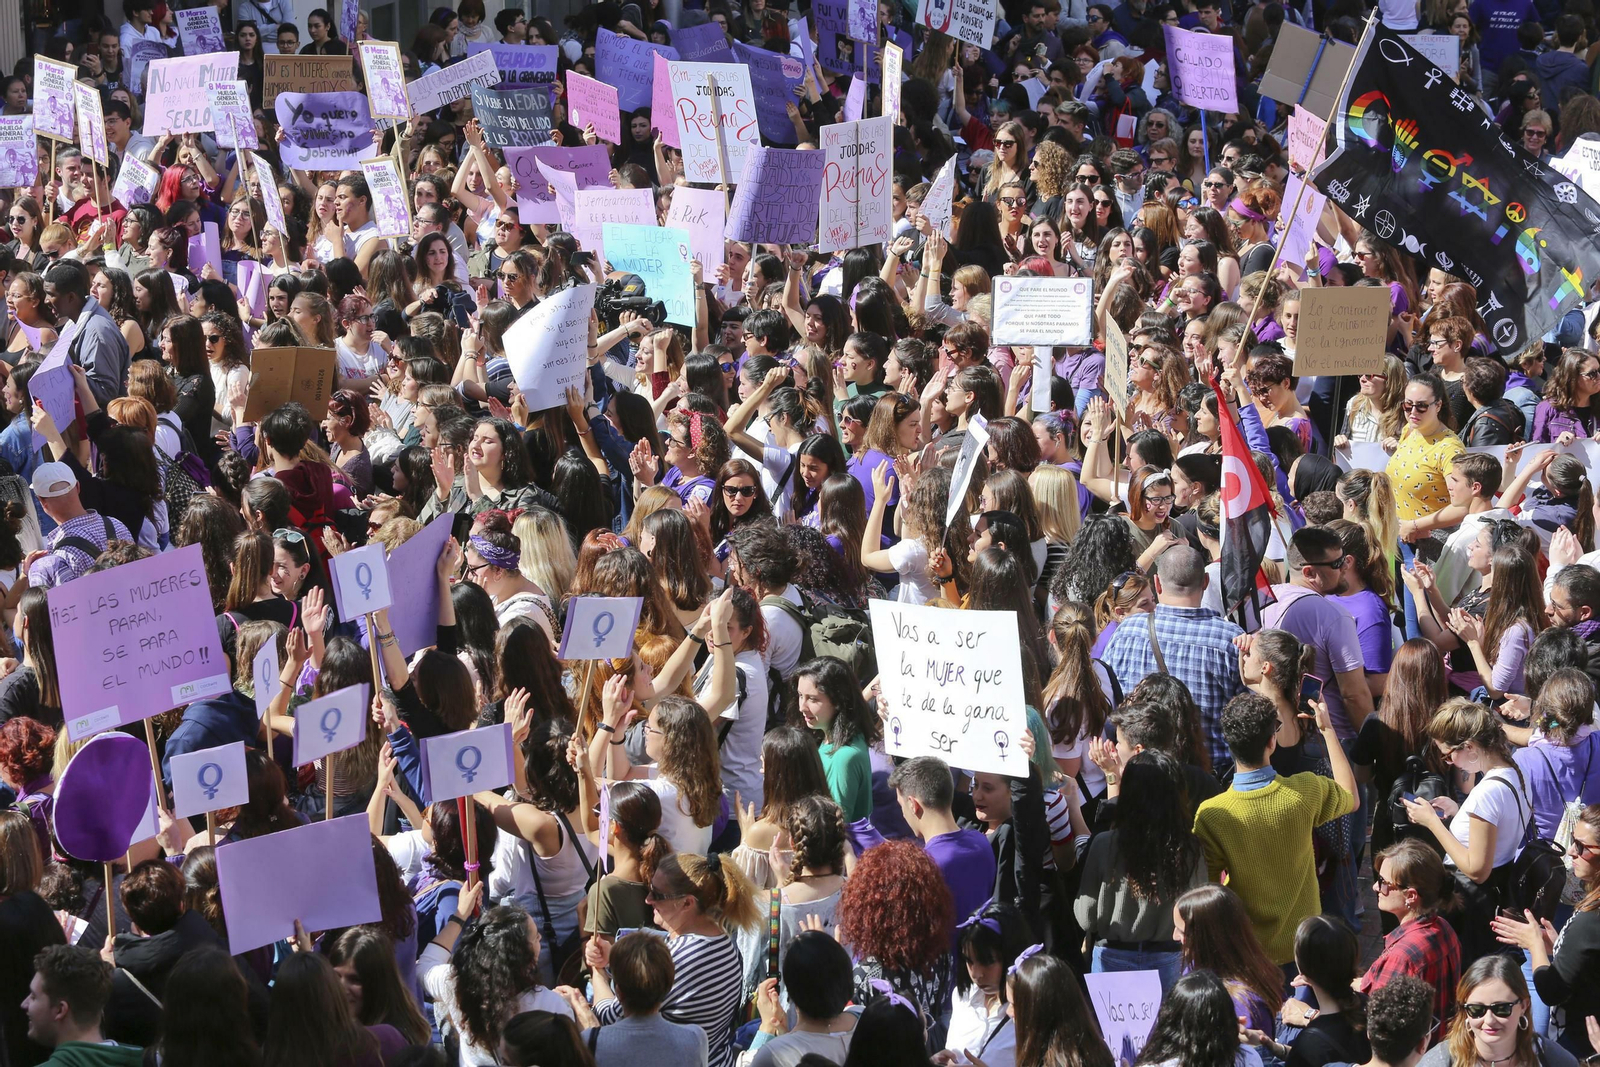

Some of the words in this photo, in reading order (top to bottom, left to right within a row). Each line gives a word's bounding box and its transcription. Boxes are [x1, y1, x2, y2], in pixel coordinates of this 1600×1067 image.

[600, 32, 628, 50] SOMOS
[632, 44, 642, 55] EL
[959, 26, 984, 44] QUEMAR
[371, 46, 389, 54] Marzo
[1174, 48, 1222, 68] CALLADO
[265, 60, 276, 78] NO
[281, 62, 290, 78] ES
[293, 60, 331, 78] MUJERES
[601, 49, 610, 60] DE
[612, 52, 630, 65] LAS
[634, 60, 650, 71] QUE
[44, 64, 65, 75] Marzo
[508, 70, 517, 82] LA
[518, 70, 556, 83] GRAVEDAD
[618, 68, 654, 86] TIENEN
[150, 66, 170, 94] NO
[1184, 83, 1230, 101] LIBERTAD
[504, 98, 516, 110] LA
[514, 94, 548, 110] EDAD
[161, 106, 212, 130] SERLO
[284, 98, 315, 126] Yo
[320, 104, 358, 132] quiero
[498, 116, 519, 130] ESTOY
[518, 116, 532, 130] DEL
[531, 117, 552, 130] LADO
[340, 130, 355, 139] no
[492, 132, 508, 145] LAS
[840, 140, 876, 160] JODDAS
[131, 159, 149, 176] Marzo
[365, 165, 370, 173] 8
[370, 164, 386, 172] Marzo
[590, 211, 640, 223] REBELDÍA
[797, 204, 818, 223] DE
[612, 226, 630, 241] EL
[624, 243, 639, 256] DE
[646, 246, 660, 258] LA
[622, 258, 666, 275] MUJER
[1308, 296, 1324, 316] Lo
[1332, 304, 1378, 316] contrario
[1310, 318, 1322, 330] al
[1327, 316, 1376, 331] feminismo
[1305, 336, 1316, 348] es
[1320, 334, 1330, 348] la
[1334, 334, 1384, 348] ignorancia
[1334, 354, 1380, 370] machismo)
[88, 592, 120, 615] LAS
[130, 569, 202, 604] MUJERES
[108, 608, 163, 636] PARAN,
[891, 611, 919, 642] Vas
[928, 630, 940, 645] a
[956, 631, 988, 649] ser
[102, 644, 129, 663] SE
[139, 630, 180, 652] PARA
[900, 650, 915, 678] la
[926, 658, 966, 687] MUJER
[974, 668, 1002, 694] que
[102, 675, 128, 690] EL
[902, 687, 912, 708] te
[921, 692, 936, 714] de
[942, 696, 956, 716] la
[962, 704, 1010, 734] gana
[1098, 990, 1125, 1022] Vas
[1128, 1002, 1140, 1020] a
[1142, 1002, 1154, 1021] ser
